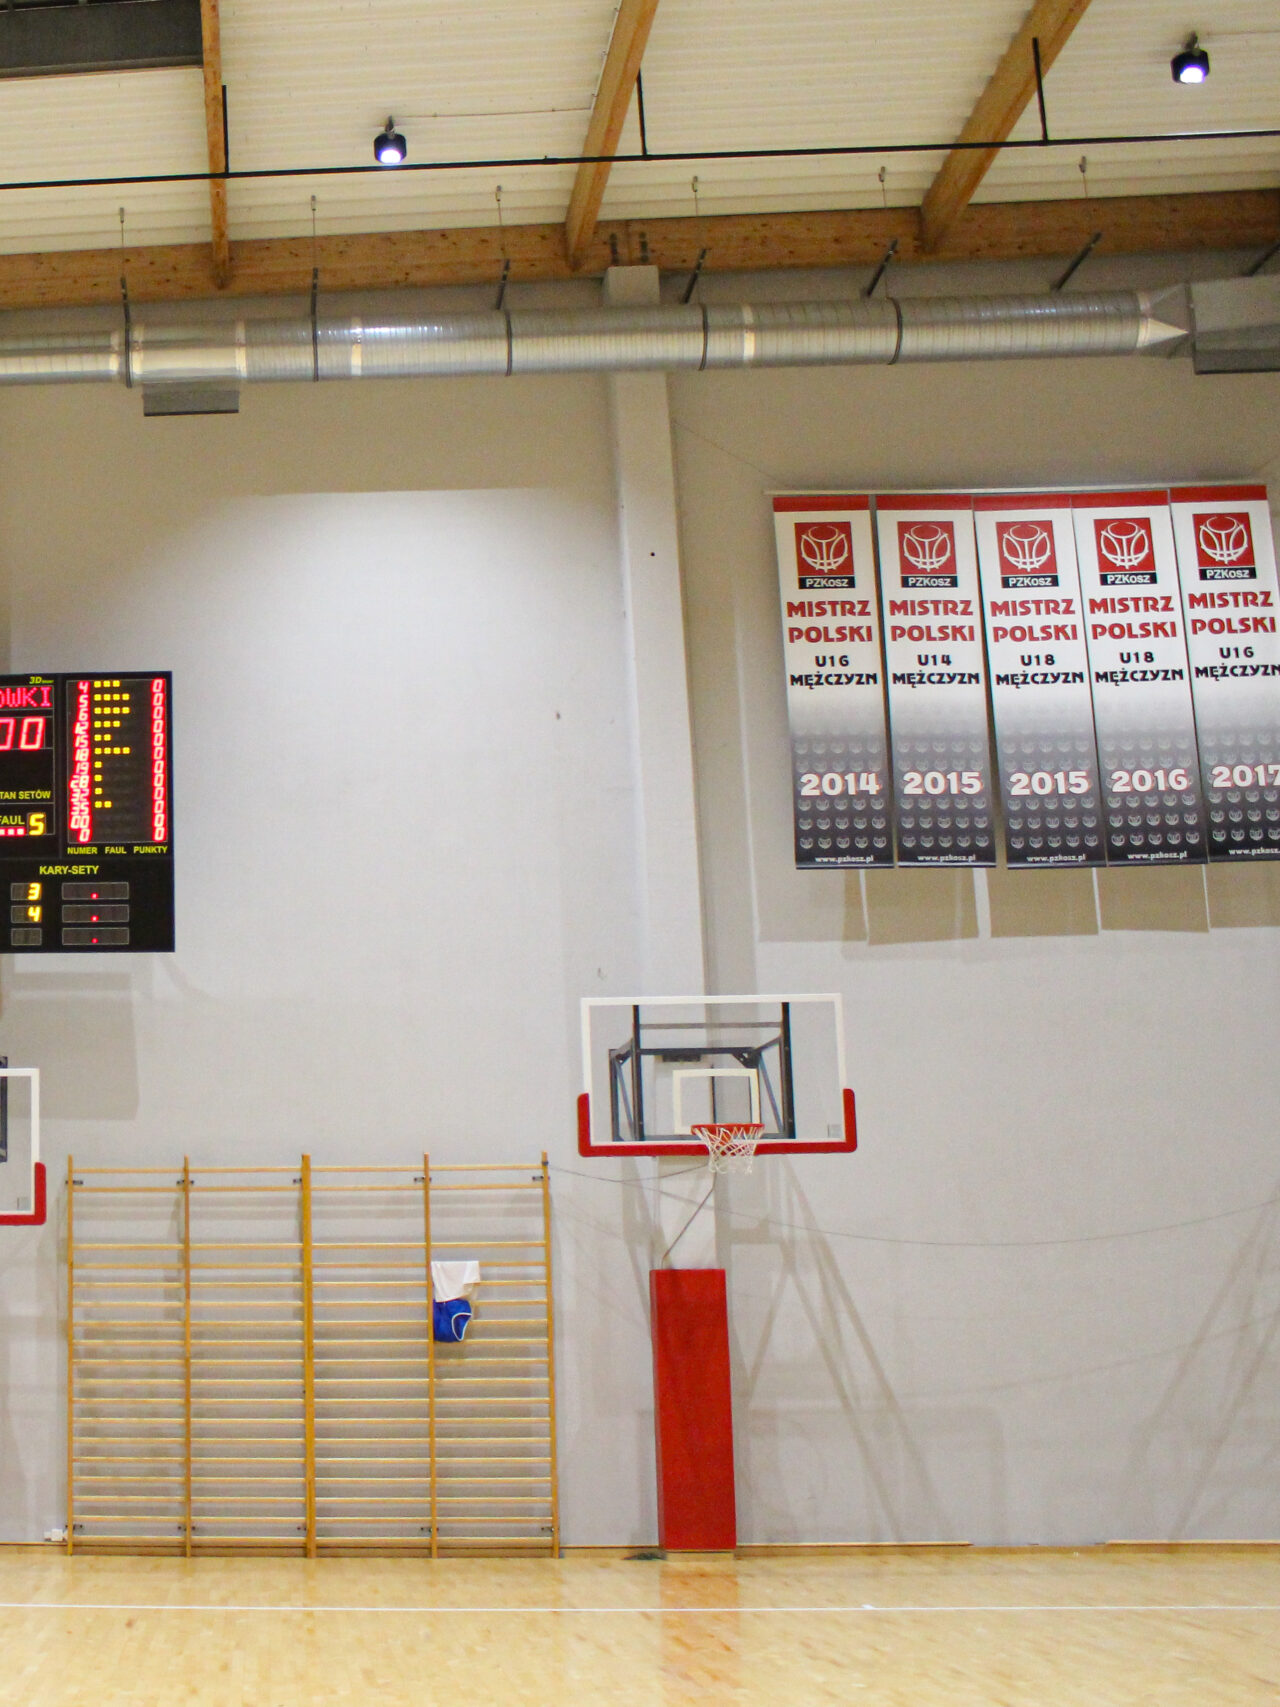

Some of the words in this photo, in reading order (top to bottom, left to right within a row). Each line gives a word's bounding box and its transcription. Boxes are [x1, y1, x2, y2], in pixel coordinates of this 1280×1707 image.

[786, 600, 871, 618] MISTRZ
[889, 599, 974, 616] MISTRZ
[990, 599, 1076, 617] MISTRZ
[1089, 596, 1174, 615] MISTRZ
[1188, 591, 1274, 609] MISTRZ
[788, 625, 873, 644] POLSKI
[890, 625, 975, 642] POLSKI
[993, 624, 1078, 642] POLSKI
[1091, 621, 1177, 640] POLSKI
[1191, 617, 1276, 635] POLSKI
[814, 655, 850, 667] U16
[917, 654, 952, 666] U14
[1020, 654, 1055, 666] U18
[1119, 651, 1155, 664] U18
[1219, 647, 1255, 659] U16
[790, 671, 878, 690] MĘŻCZYZN
[892, 670, 980, 688] MĘŻCZYZN
[995, 669, 1084, 689] MĘŻCZYZN
[1094, 666, 1184, 687] MĘŻCZYZN
[1195, 662, 1280, 682] MĘŻCZYZN
[800, 772, 881, 796] 2014
[903, 771, 983, 795] 2015
[1009, 770, 1091, 796] 2015
[1111, 768, 1189, 793] 2016
[1211, 765, 1280, 788] 2017
[17, 790, 51, 799] SETÓW
[105, 846, 127, 854] FAUL
[39, 865, 99, 875] KARY-SETY
[28, 883, 41, 900] 3
[27, 906, 41, 922] 4
